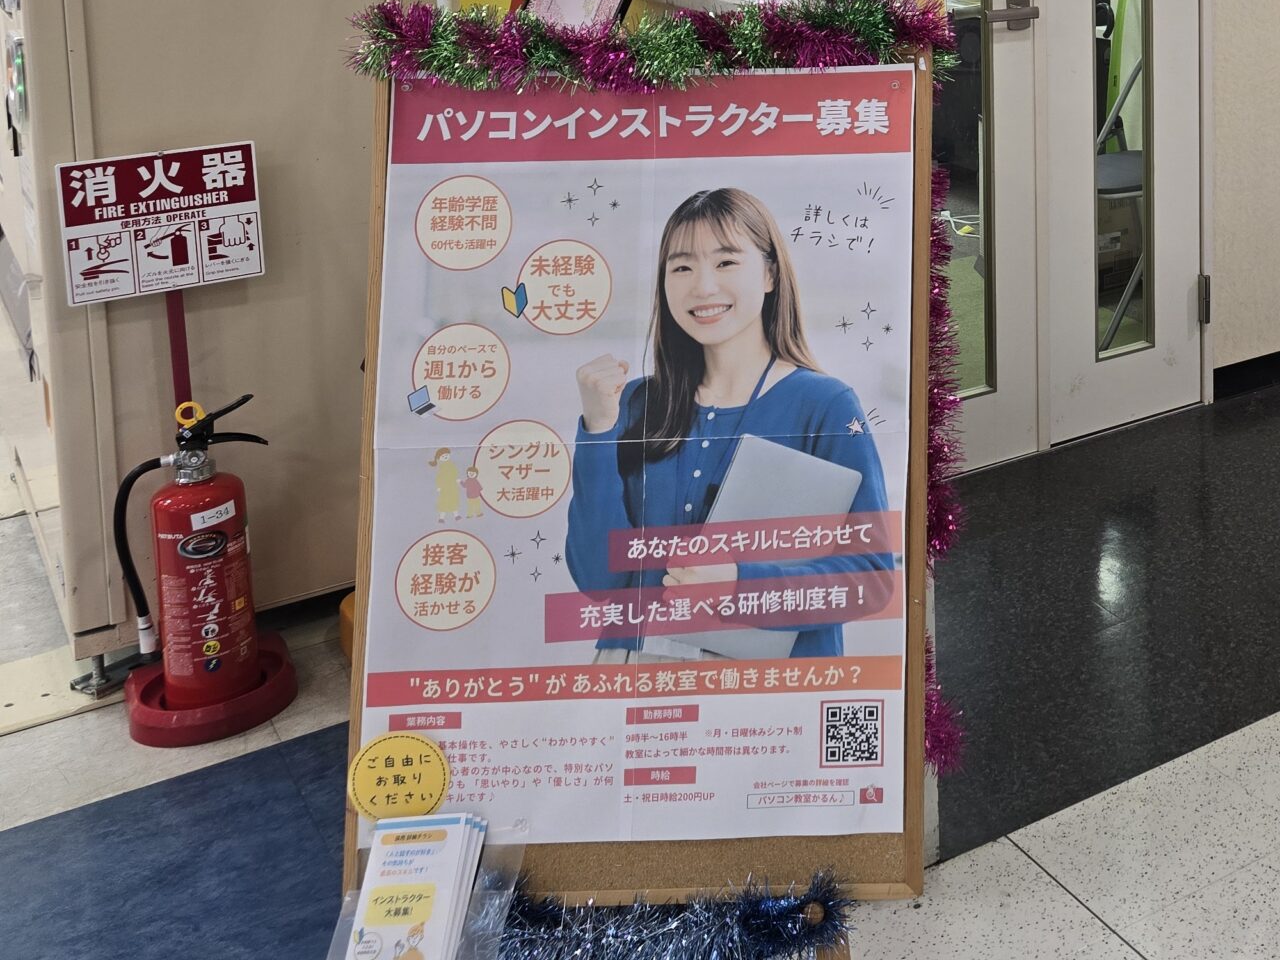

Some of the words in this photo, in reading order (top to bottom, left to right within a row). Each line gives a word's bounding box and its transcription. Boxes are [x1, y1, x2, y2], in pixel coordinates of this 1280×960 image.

[417, 99, 890, 143] パソコンインストラクター募集
[69, 150, 247, 208] 消火器
[94, 204, 125, 220] FIRE
[130, 191, 229, 215] EXTINGUISHER
[431, 195, 499, 213] 年齢学歴
[120, 216, 162, 229] 使用方法
[166, 210, 207, 223] OPERATE
[430, 214, 498, 232] 経験不問
[803, 204, 870, 231] 詳しくは
[430, 238, 498, 251] 60代も活躍中
[530, 255, 596, 277] 未経験
[548, 283, 576, 297] でも
[531, 300, 598, 323] 大丈夫
[427, 343, 498, 356] 自分のペースで
[424, 359, 498, 381] 週1から
[437, 384, 482, 402] 働ける
[488, 441, 561, 460] シングル
[497, 463, 551, 482] マザー
[496, 485, 555, 503] 大活躍中
[627, 522, 874, 560] あなたのスキルに合わせて
[422, 543, 468, 567] 接客
[410, 572, 481, 596] 経験が
[413, 600, 478, 618] 活かせる
[406, 716, 446, 728] 業務内容
[643, 708, 682, 720] 勤務時間
[625, 744, 790, 758] 教室によって細かな時間帯は異なります。
[367, 753, 431, 769] ご自由に
[376, 773, 422, 787] お取り
[650, 770, 670, 781] 時給
[369, 793, 434, 806] ください
[624, 792, 715, 804] 土・祝日時給200円UP
[372, 893, 431, 905] インストラクター
